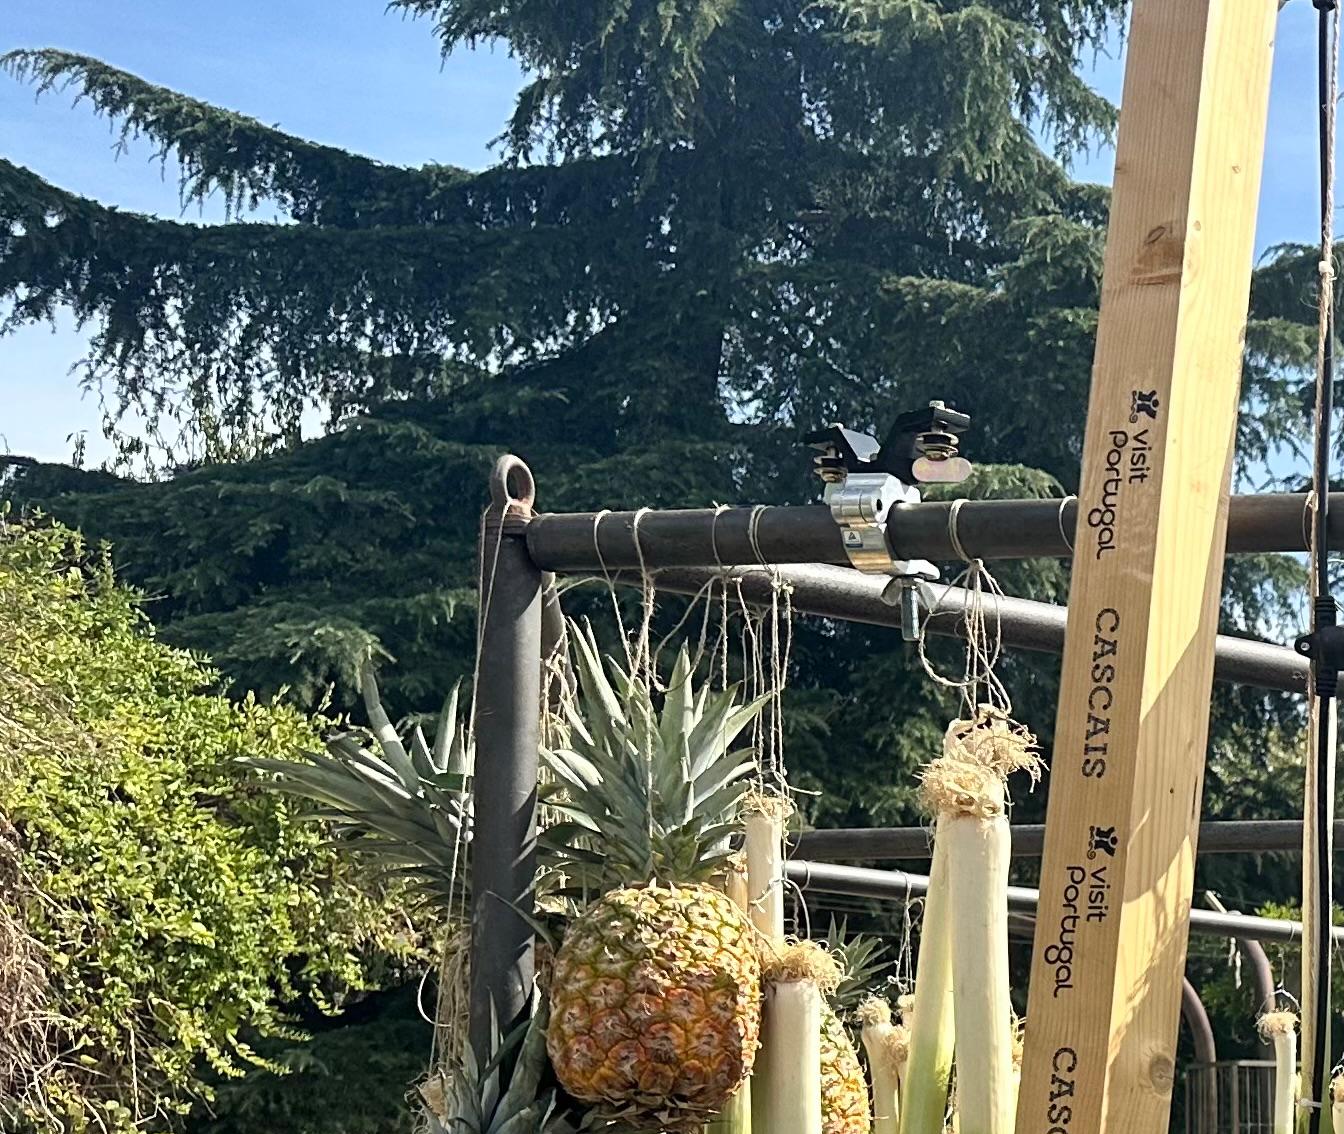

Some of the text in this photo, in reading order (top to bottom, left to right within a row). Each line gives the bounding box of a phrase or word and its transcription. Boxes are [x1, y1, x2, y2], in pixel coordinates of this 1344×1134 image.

[1087, 431, 1129, 560] Portugal
[1128, 429, 1153, 484] visit
[1082, 608, 1120, 778] CASCAIS
[1044, 866, 1086, 998] Portugal
[1086, 866, 1111, 922] visit
